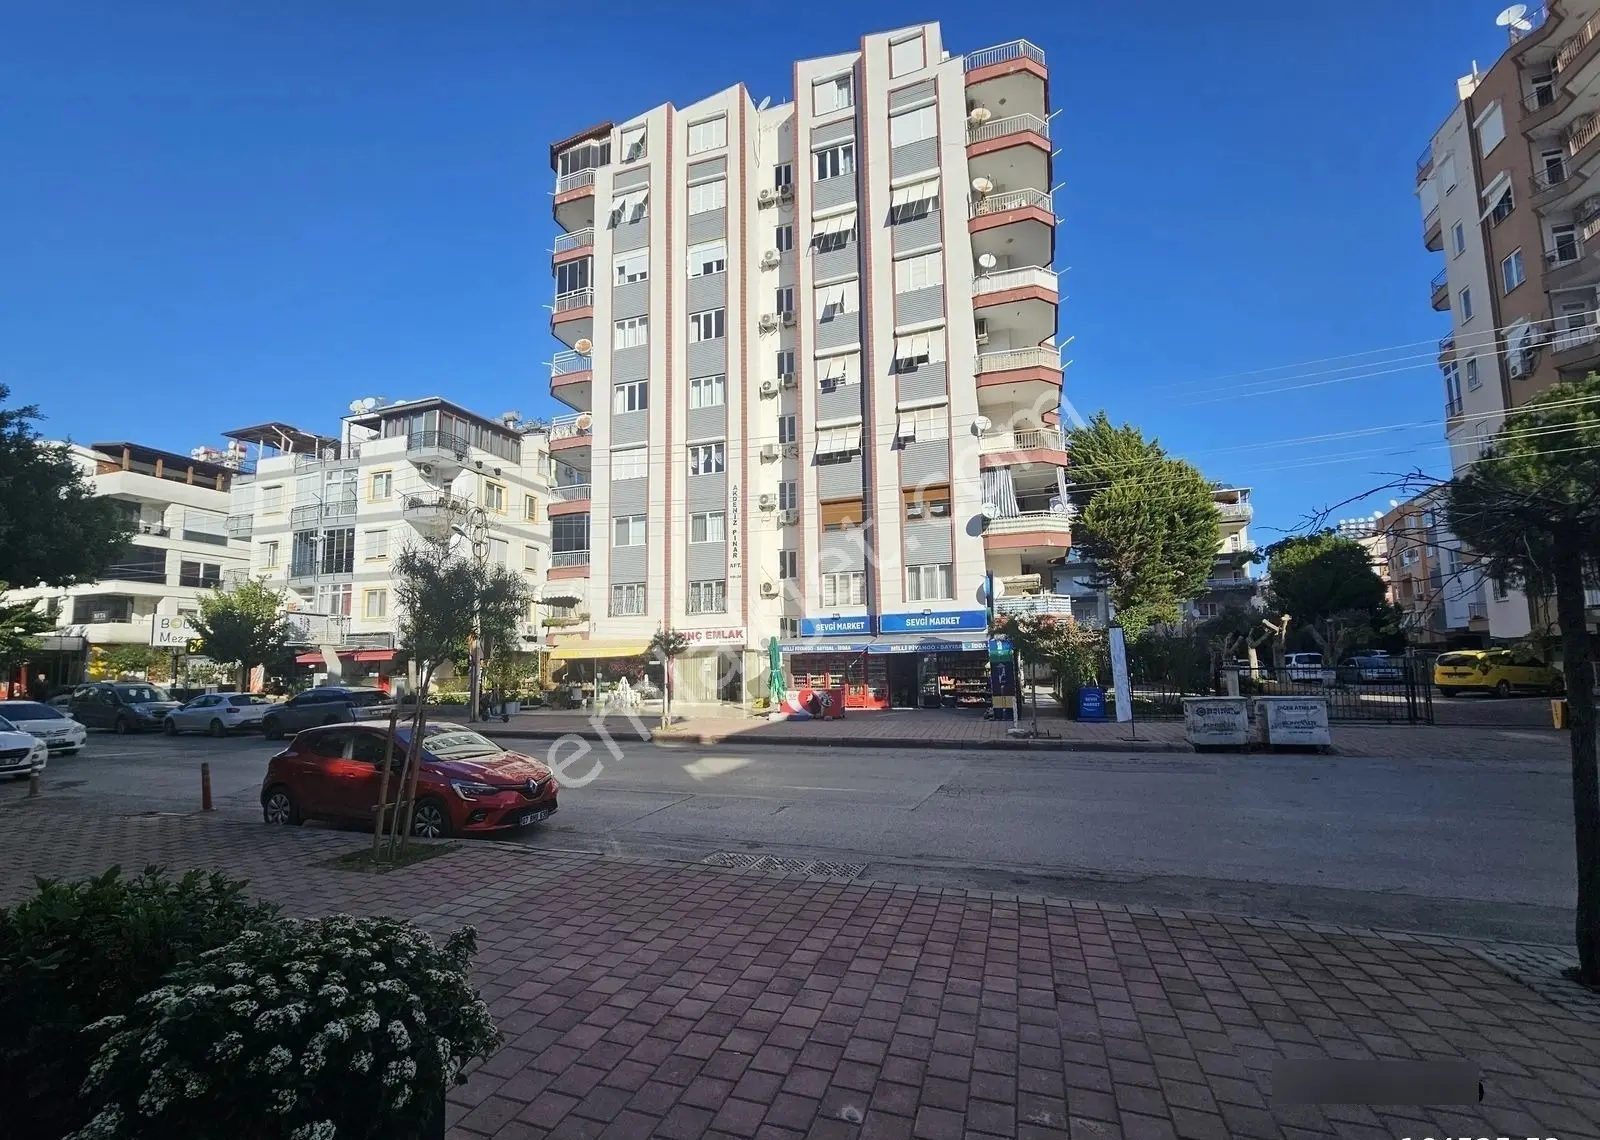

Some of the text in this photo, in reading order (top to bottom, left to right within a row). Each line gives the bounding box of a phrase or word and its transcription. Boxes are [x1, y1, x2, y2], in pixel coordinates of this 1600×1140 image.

[816, 620, 865, 632] SEVGİ MARKET
[905, 616, 960, 627] SEVGİ MARKET
[705, 629, 744, 640] EMLAK
